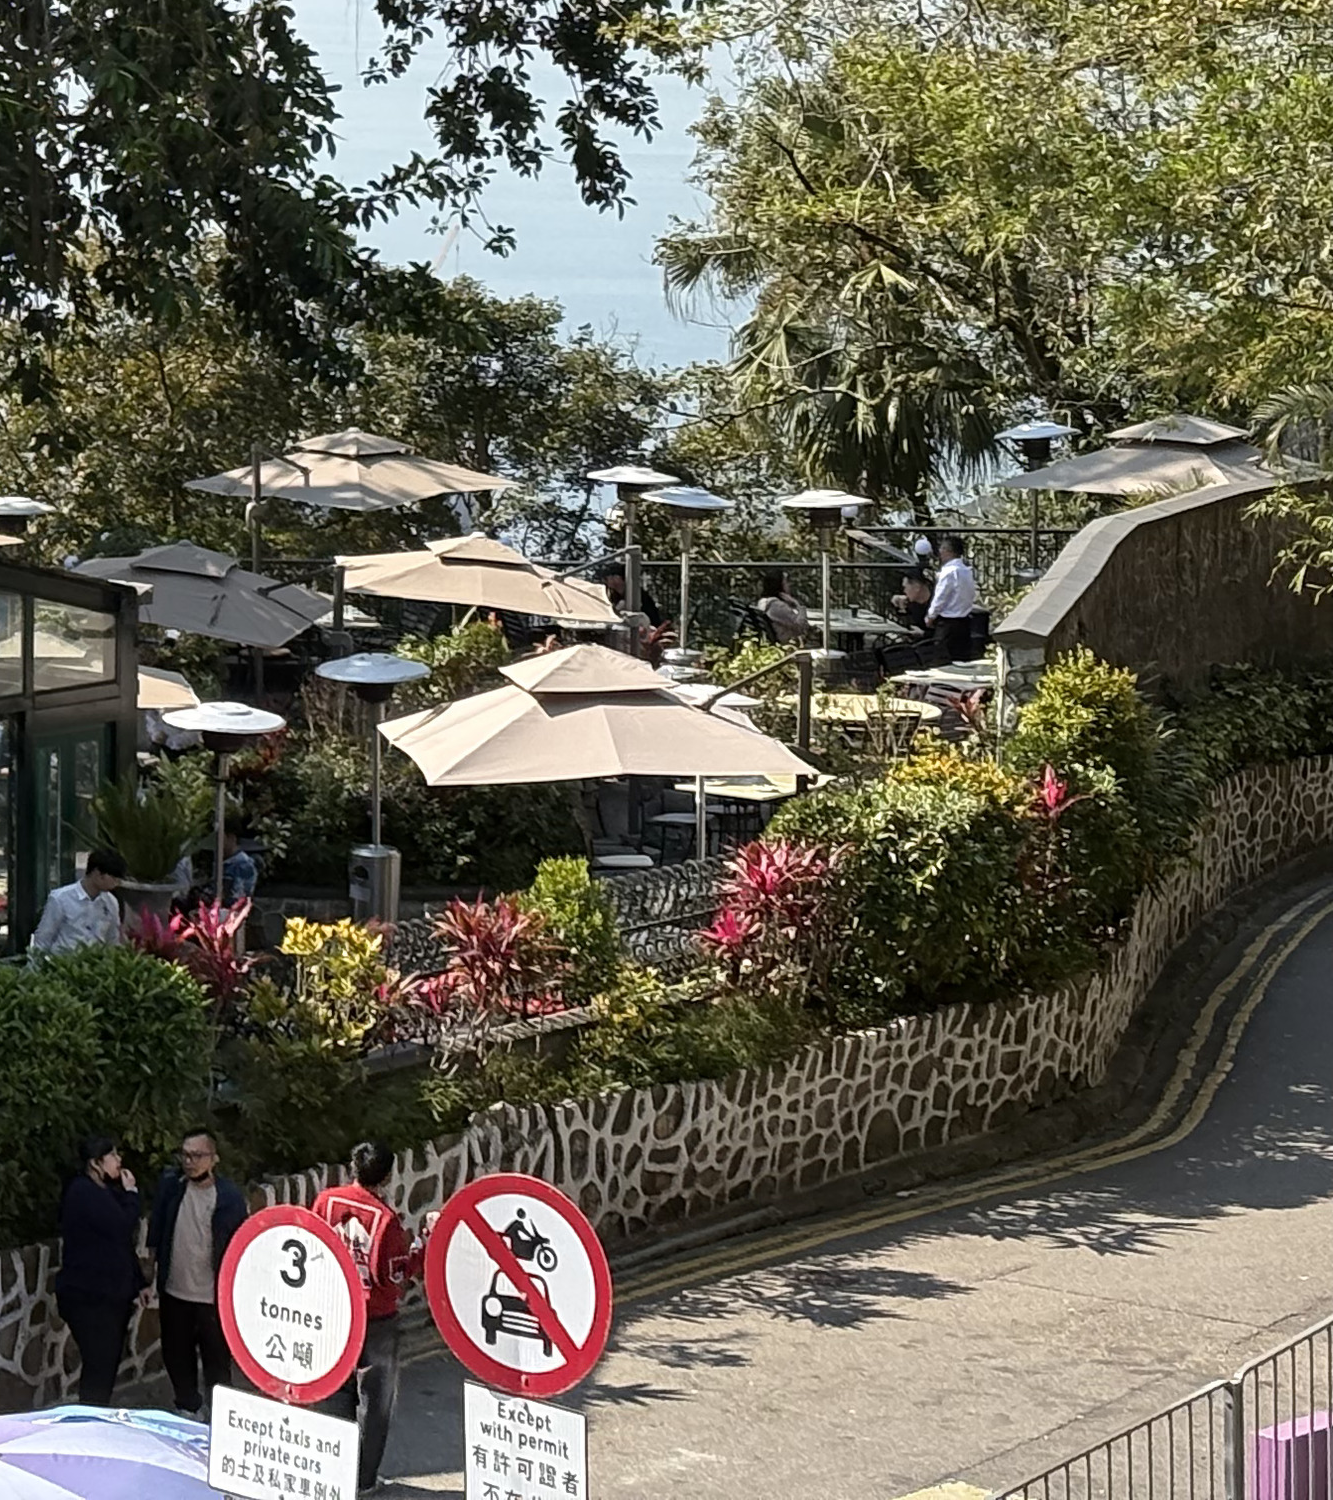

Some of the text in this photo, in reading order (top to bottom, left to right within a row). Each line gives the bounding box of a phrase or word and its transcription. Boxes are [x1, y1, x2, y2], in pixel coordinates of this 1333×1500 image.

[279, 1238, 308, 1289] 3
[260, 1296, 323, 1331] tonnes
[228, 1409, 341, 1458] Except taxis and
[497, 1401, 552, 1433] Except
[243, 1440, 322, 1474] private cars
[479, 1420, 570, 1460] with permit
